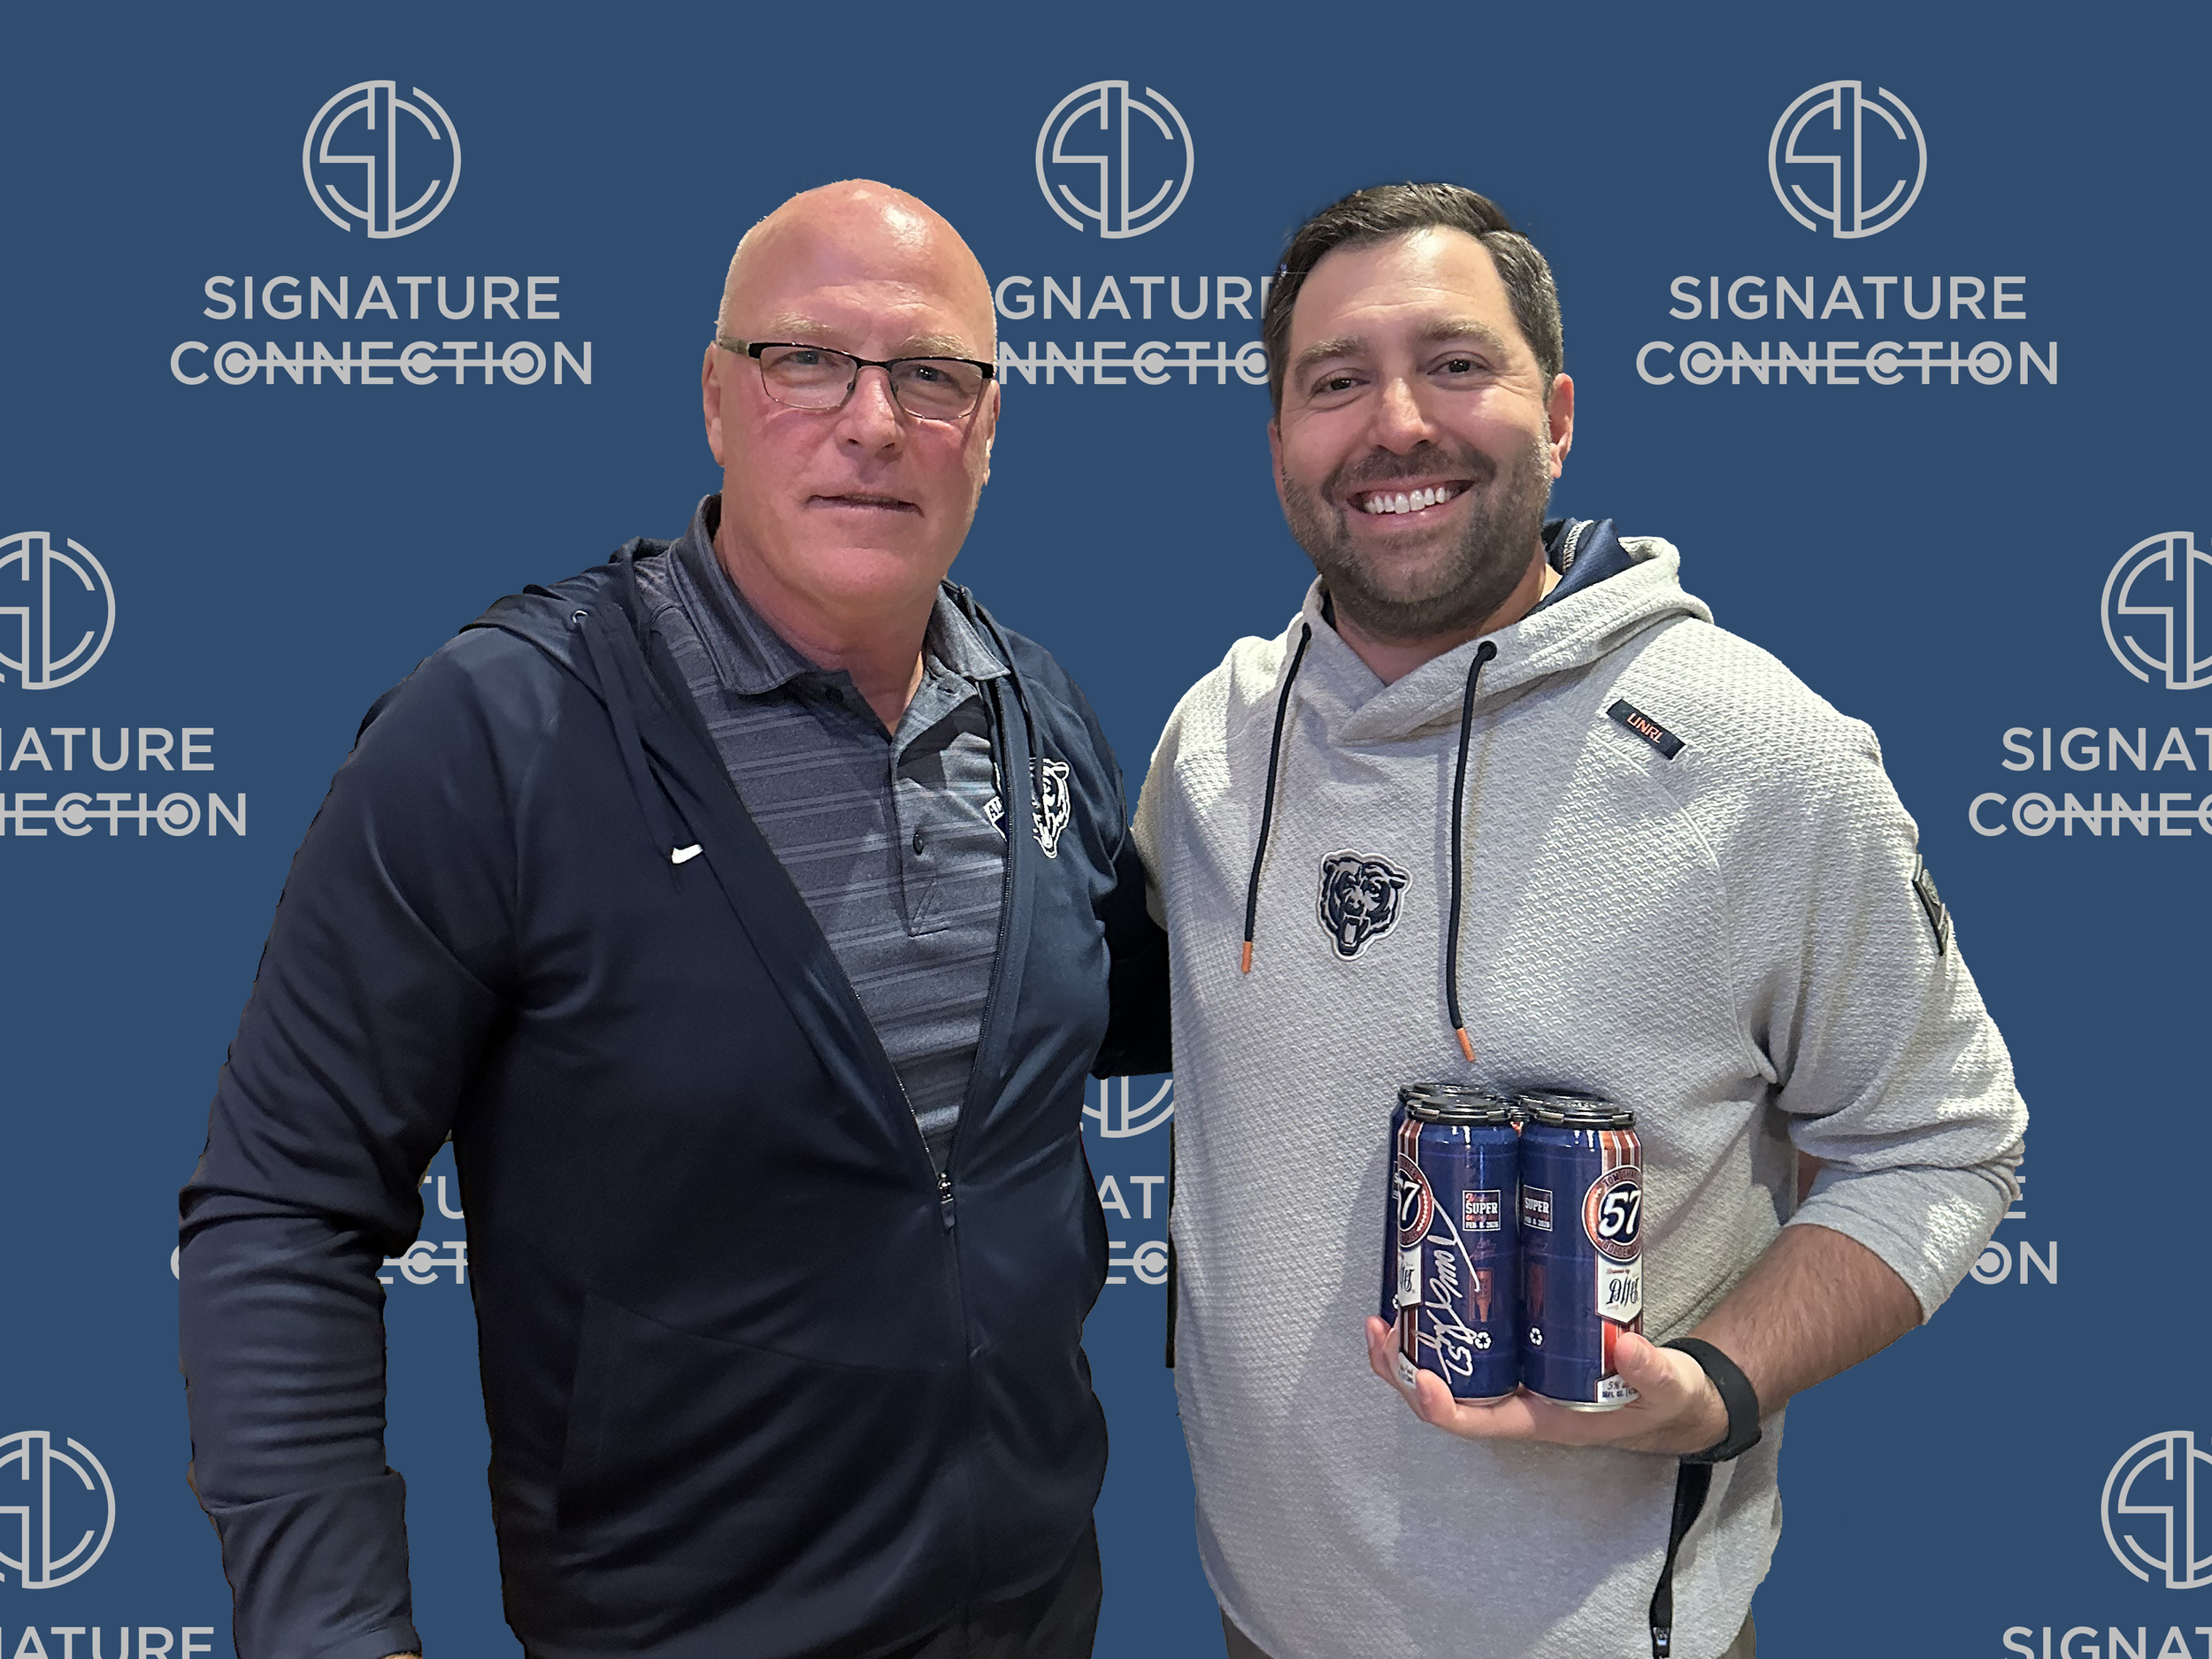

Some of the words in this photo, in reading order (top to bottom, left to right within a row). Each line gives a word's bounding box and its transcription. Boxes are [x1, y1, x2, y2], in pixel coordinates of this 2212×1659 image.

[203, 276, 560, 319] SIGNATURE
[1669, 276, 2026, 319] SIGNATURE
[171, 342, 592, 385] CONNECTION
[1636, 342, 2058, 385] CONNECTION
[0, 727, 214, 771] ATURE
[1626, 712, 1663, 743] UNRL
[0, 793, 246, 836] ECTION
[1602, 1172, 1619, 1187] TOM
[1465, 1202, 1498, 1215] SUPER
[1525, 1197, 1549, 1214] SUPER
[1599, 1189, 1641, 1237] 57
[0, 1626, 214, 1659] ATURE
